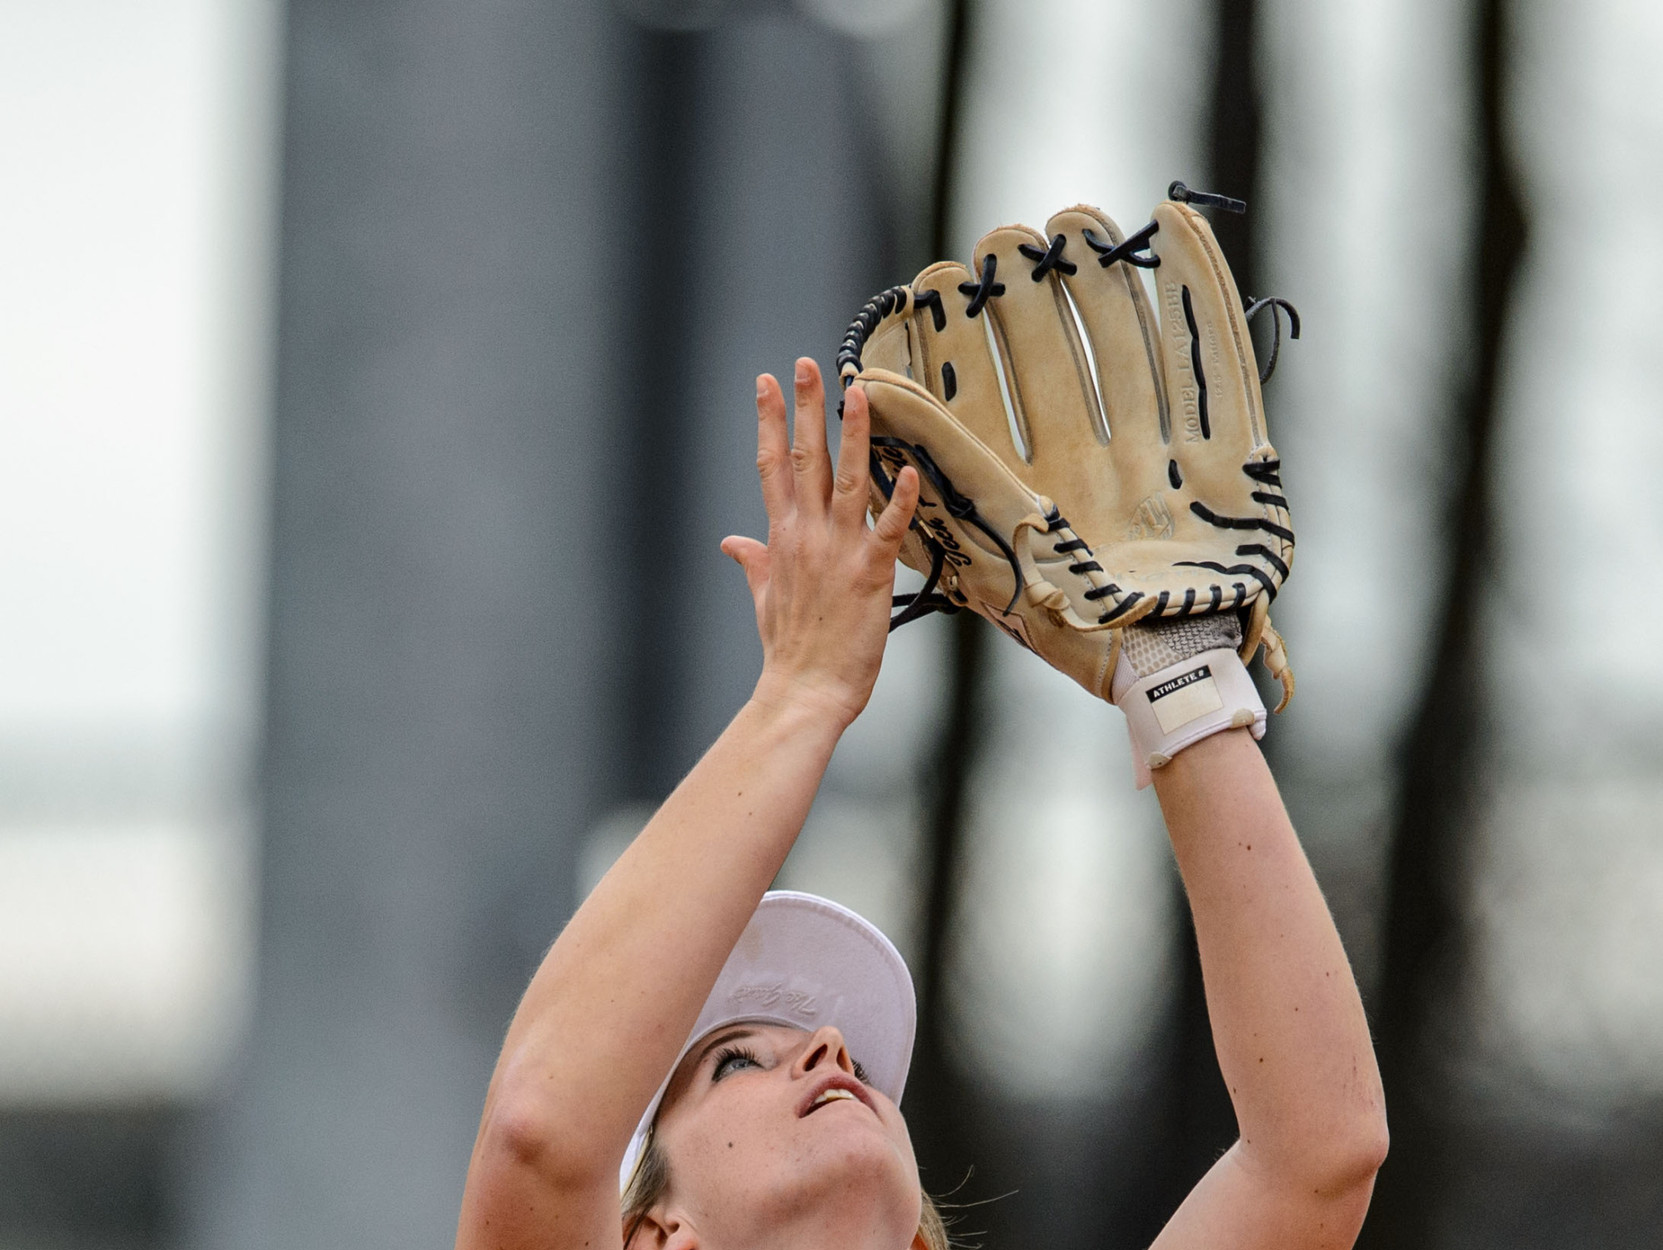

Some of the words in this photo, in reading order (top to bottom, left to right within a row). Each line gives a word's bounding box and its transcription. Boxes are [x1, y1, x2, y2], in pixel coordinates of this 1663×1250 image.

[1182, 376, 1200, 444] MODEL
[929, 516, 973, 567] Tech
[1153, 673, 1197, 698] ATHLETE
[1198, 669, 1204, 677] #
